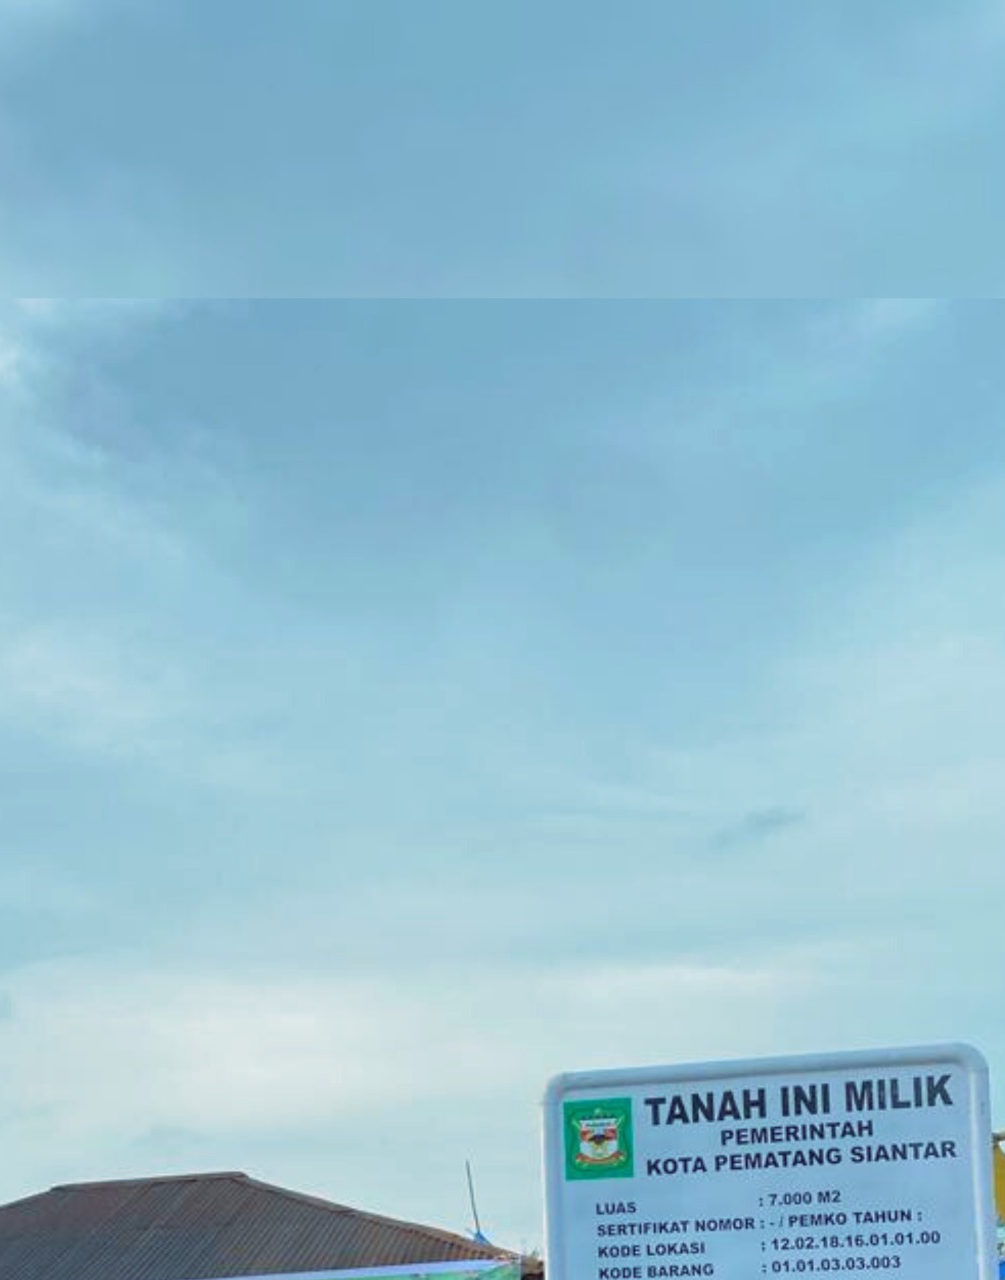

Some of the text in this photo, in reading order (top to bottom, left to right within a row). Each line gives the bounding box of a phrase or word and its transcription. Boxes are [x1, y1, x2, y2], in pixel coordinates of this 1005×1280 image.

[644, 1074, 953, 1126] TANAH INI MILIK
[721, 1120, 874, 1146] PEMERINTAH
[646, 1140, 958, 1177] KOTA PEMATANG SIANTAR
[595, 1201, 637, 1216] LUAS
[768, 1192, 813, 1207] 7.000
[817, 1189, 842, 1204] M2
[597, 1219, 690, 1237] SERTIFIKAT
[694, 1217, 756, 1232] NOMOR
[788, 1211, 848, 1228] PEMKO
[854, 1209, 913, 1225] TAHUN
[597, 1244, 642, 1259] KODE
[646, 1241, 706, 1257] LOKASI
[771, 1230, 942, 1251] 12.02.18.16.01.01.00
[598, 1266, 643, 1280] KODE
[647, 1262, 715, 1279] BARANG
[771, 1254, 902, 1274] 01.01.03.03.003
